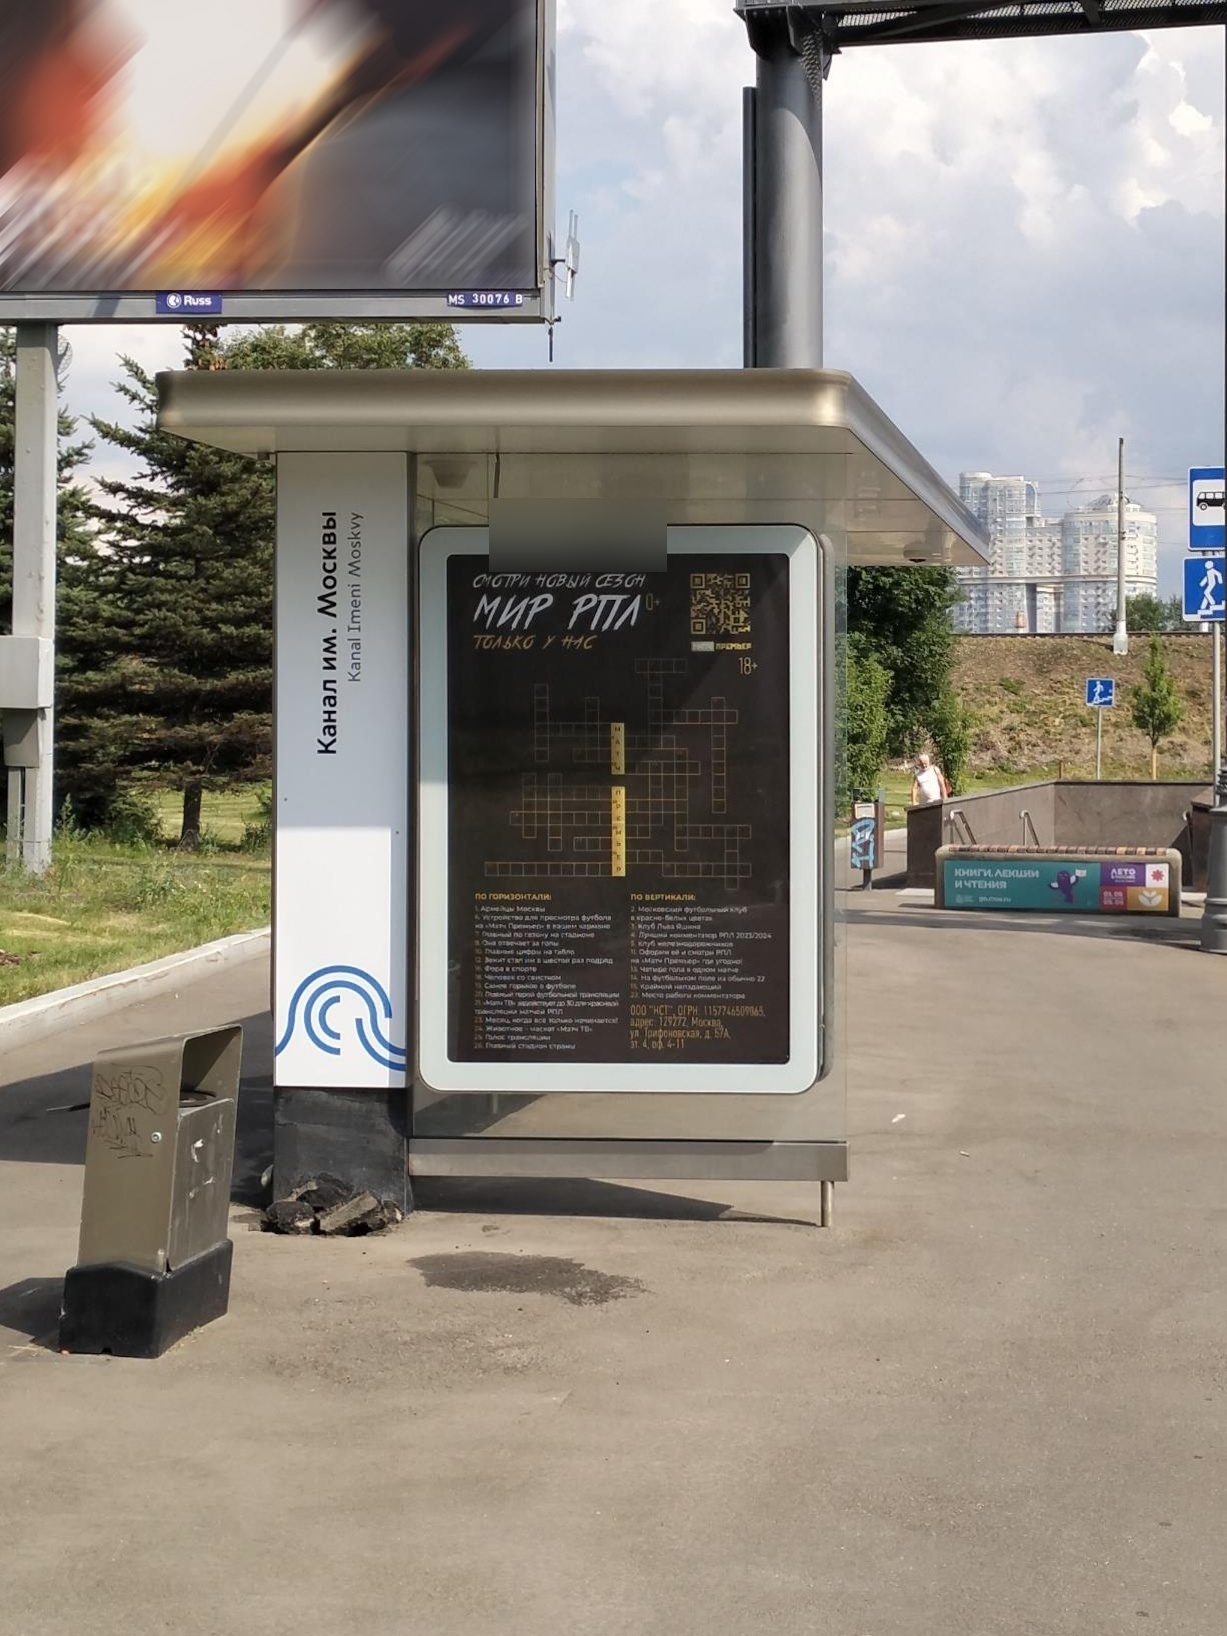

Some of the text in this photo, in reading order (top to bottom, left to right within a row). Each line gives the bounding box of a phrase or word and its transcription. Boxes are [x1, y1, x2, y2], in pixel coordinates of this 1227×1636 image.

[184, 295, 212, 307] Russ
[448, 293, 523, 305] MS 30076 B
[472, 572, 646, 588] СМОТРИ НОВЫЙ СЕЗОН
[347, 512, 364, 682] Kanal Imeni Moskvy
[473, 593, 642, 632] МИР РПЛ
[317, 511, 337, 754] Канал им. Москвы
[473, 634, 598, 650] ТОЛЬКО У НАС
[738, 657, 758, 675] 18+
[995, 869, 1040, 878] ЛЕКЦИИ
[1111, 868, 1136, 879] ЛЕТО
[955, 880, 1007, 889] И ЧТЕНИЯ
[489, 893, 551, 901] ГОРИЗОНТАЛИ:
